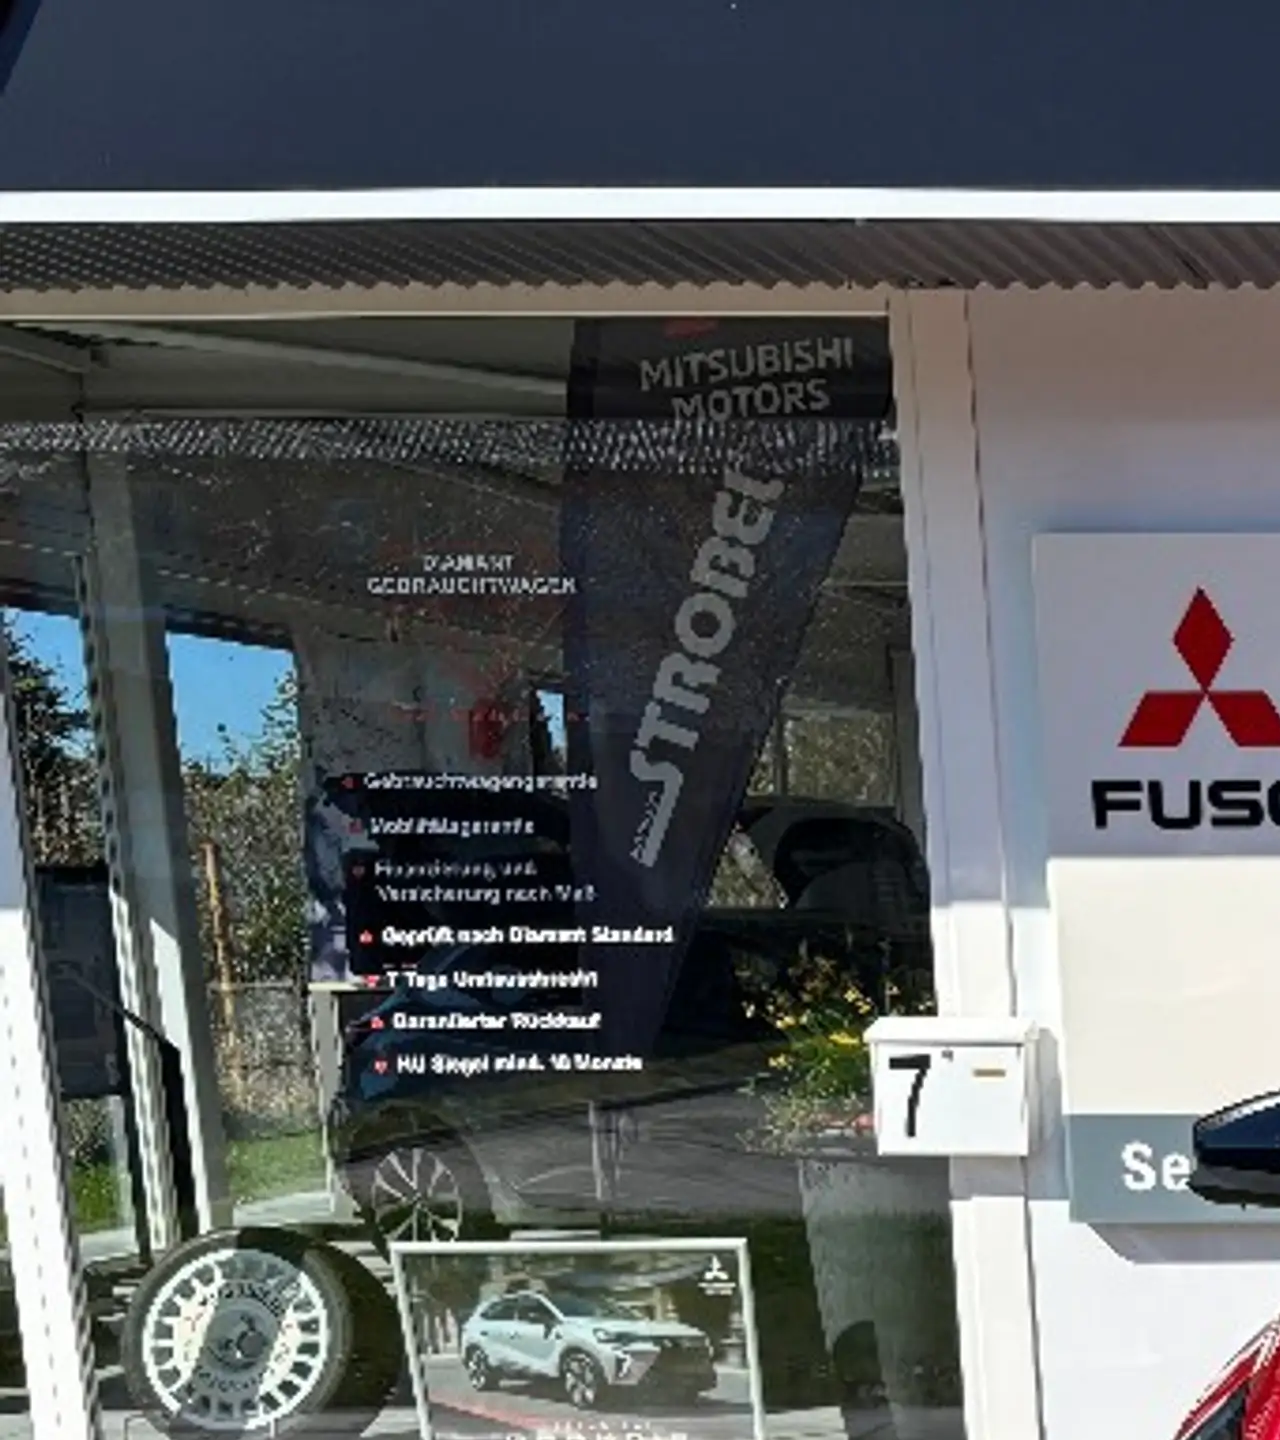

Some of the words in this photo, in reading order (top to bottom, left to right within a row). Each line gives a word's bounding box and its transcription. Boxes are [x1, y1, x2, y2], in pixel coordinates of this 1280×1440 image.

[640, 337, 853, 392] MITSUBISHI
[671, 377, 833, 424] MOTORS
[888, 1054, 932, 1139] 7
[1120, 1141, 1194, 1192] Se
